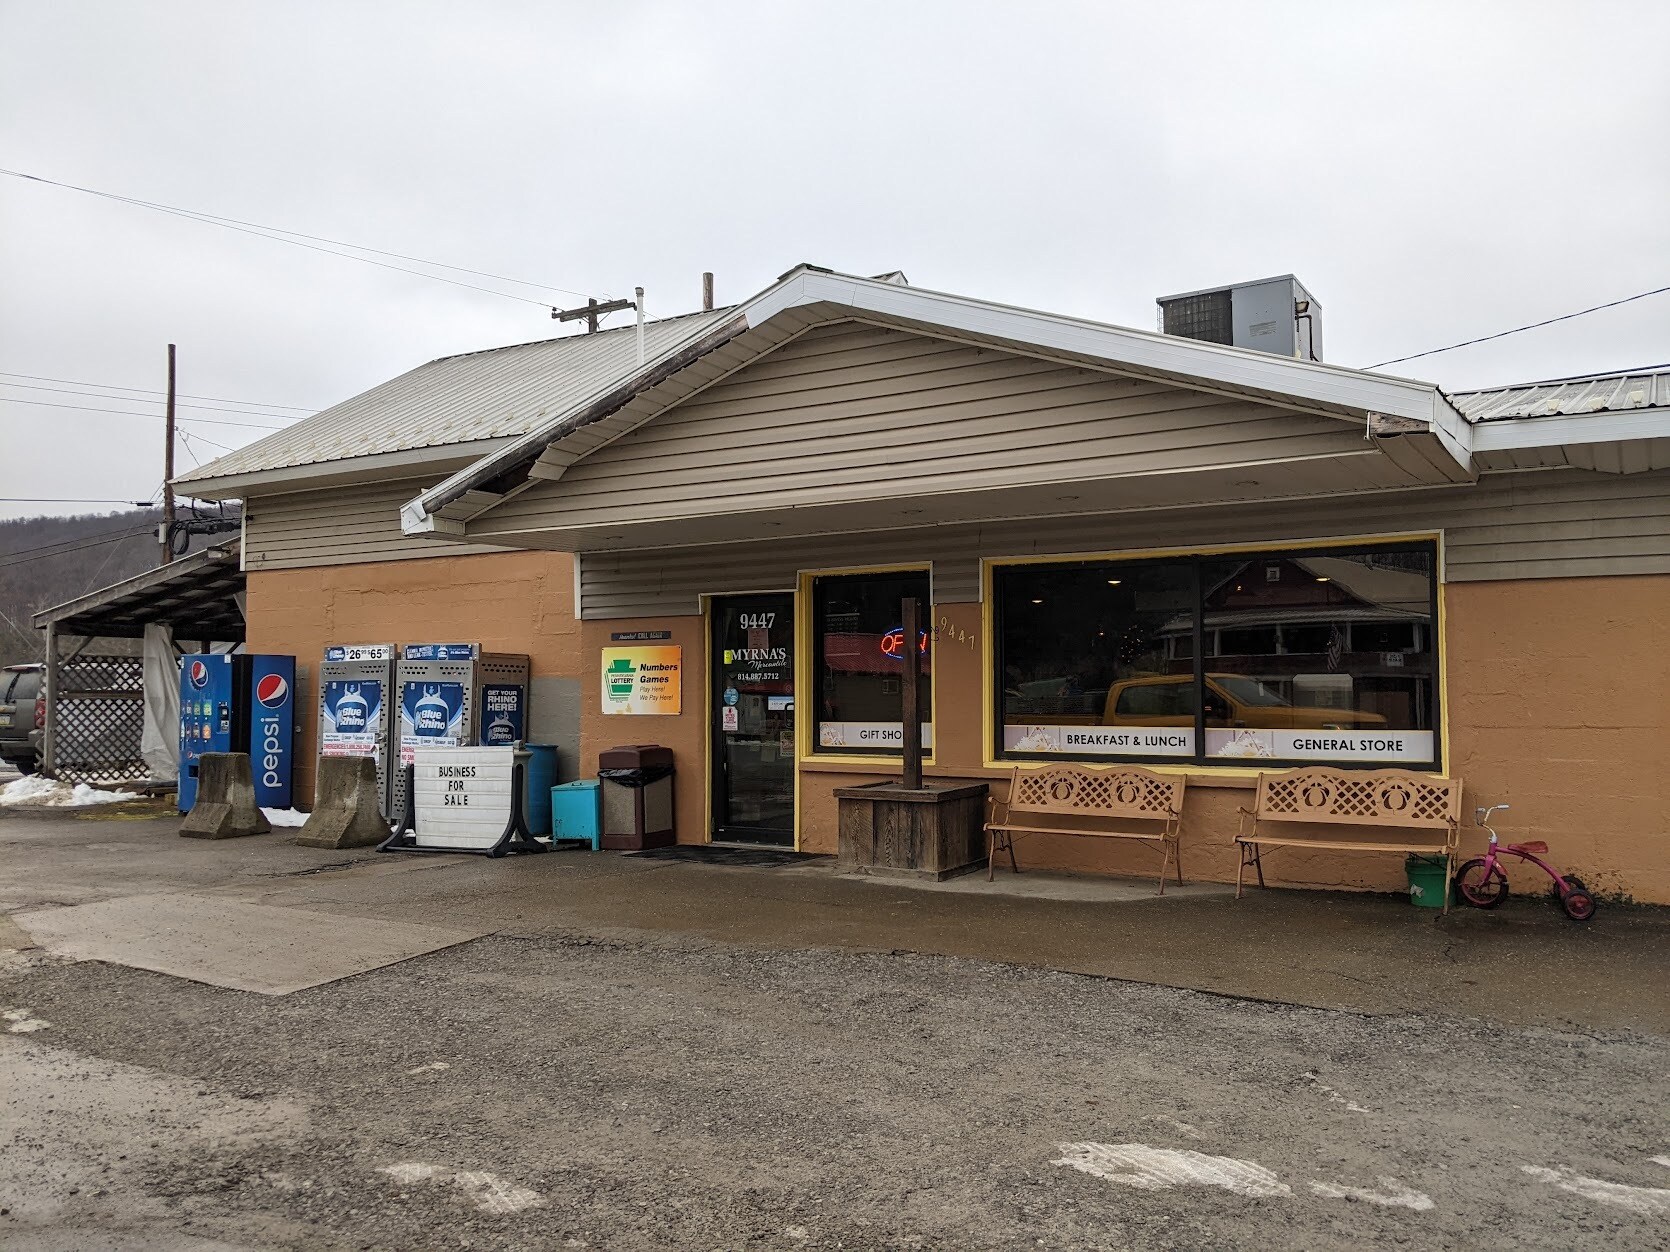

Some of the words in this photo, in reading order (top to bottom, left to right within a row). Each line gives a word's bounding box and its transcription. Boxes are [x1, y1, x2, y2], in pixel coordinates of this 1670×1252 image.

[740, 613, 775, 629] 9447
[940, 616, 975, 650] 9447
[731, 647, 787, 661] MYRNA'S
[640, 663, 678, 672] Numbers
[748, 658, 787, 671] Mercantile
[640, 675, 669, 684] Games
[487, 695, 518, 704] RHINO
[649, 694, 659, 702] Pay
[342, 707, 362, 717] Blue
[487, 703, 517, 712] HERE!
[420, 710, 442, 720] Blue
[860, 730, 880, 740] GIFT
[881, 730, 903, 740] SHO
[1067, 734, 1130, 746] BREAKFAST
[1133, 736, 1141, 746] &
[1145, 735, 1187, 747] LUNCH
[1293, 738, 1356, 751] GENERAL
[1360, 739, 1403, 752] STORE
[260, 717, 283, 788] pepsi
[438, 766, 476, 778] BUSINESS
[448, 780, 464, 791] FOR
[444, 794, 468, 806] SALE
